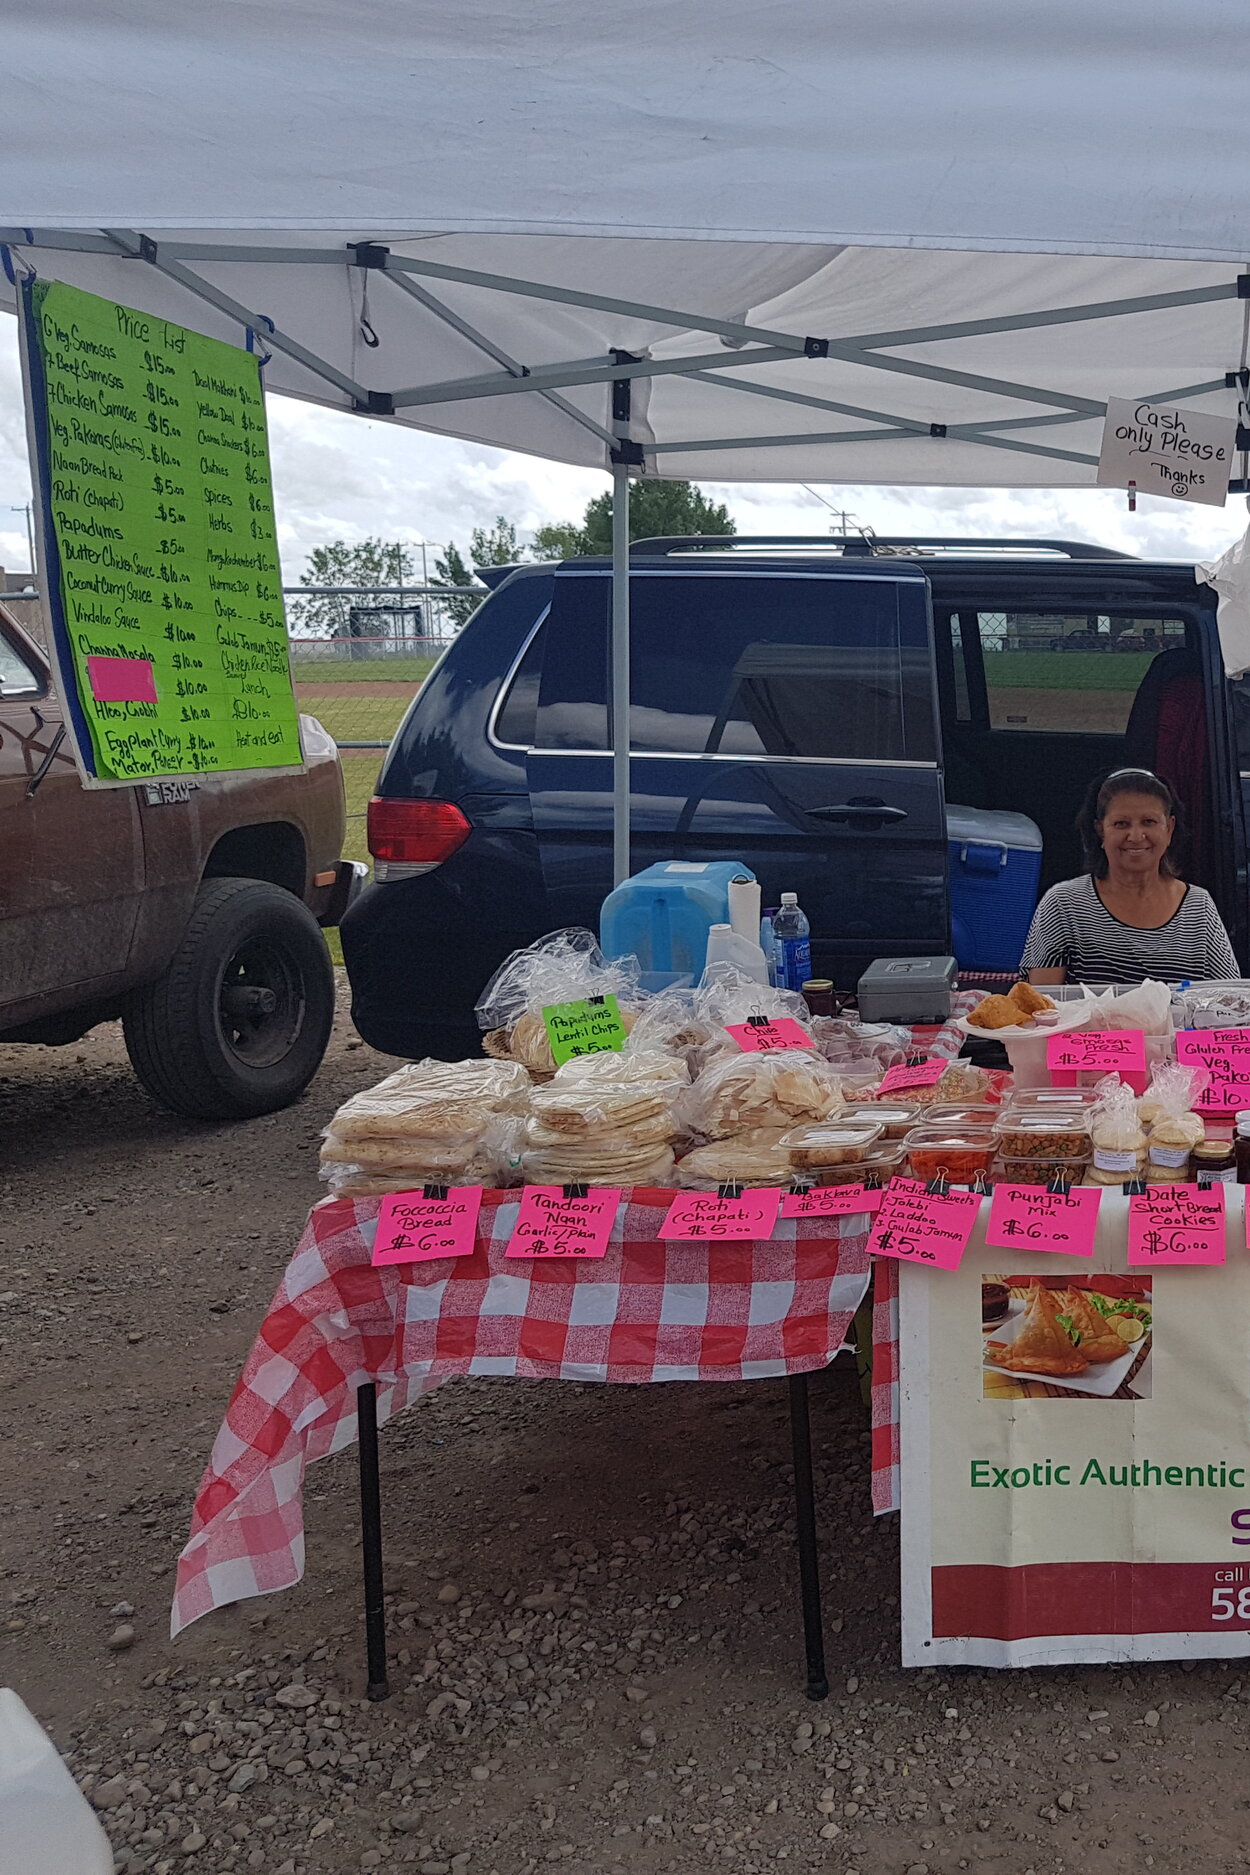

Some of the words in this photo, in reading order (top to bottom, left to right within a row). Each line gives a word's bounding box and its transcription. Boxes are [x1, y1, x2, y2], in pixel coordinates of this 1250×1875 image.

[71, 323, 117, 359] Samosas
[114, 306, 150, 342] Price
[160, 323, 187, 353] List
[56, 352, 81, 384] Beef
[81, 360, 125, 389] Samosas
[57, 381, 98, 414] Chicken
[98, 389, 138, 422] Samosas
[1134, 403, 1188, 434] Cash
[51, 414, 73, 447] Veg.
[70, 418, 113, 451] Pakoras
[1115, 426, 1153, 453] only
[1161, 431, 1226, 460] Please
[53, 450, 81, 472] Naan
[80, 457, 108, 478] Bread
[1150, 462, 1206, 485] Thanks
[53, 479, 80, 503] Roti
[83, 488, 124, 511] (Chapati)
[204, 487, 233, 506] Spices
[57, 511, 124, 540] Papadums
[208, 512, 233, 533] Herbs
[62, 539, 102, 564] Butter
[102, 544, 134, 572] Chicken
[133, 553, 155, 579] Sauce
[66, 571, 102, 594] Coconut
[101, 576, 126, 604] Curry
[127, 581, 153, 603] Sauce
[72, 598, 112, 626] Vindaloo
[114, 606, 141, 630] Sauce
[78, 634, 120, 657] Channa
[557, 1028, 590, 1043] Lentil
[591, 1022, 620, 1036] Chips
[1213, 1029, 1249, 1042] Fresh
[1201, 1056, 1235, 1072] Veg.
[530, 1193, 605, 1214] Tandoori
[888, 1178, 935, 1199] Indian
[936, 1191, 976, 1206] Sweets
[1140, 1186, 1191, 1202] Date
[690, 1199, 732, 1212] Roti
[890, 1208, 937, 1225] Laddoo
[1027, 1206, 1058, 1218] Mix
[397, 1215, 453, 1231] Bread
[544, 1211, 588, 1227] Naan
[887, 1219, 923, 1236] Gulab
[923, 1226, 964, 1242] Jamun
[1002, 1218, 1070, 1240] $6.00
[1149, 1213, 1217, 1227] Cookies
[873, 1230, 937, 1260] $5.00
[1140, 1230, 1209, 1256] $6.00
[970, 1459, 1071, 1489] Exotic
[1080, 1458, 1246, 1488] Authentic
[1215, 1567, 1244, 1582] call
